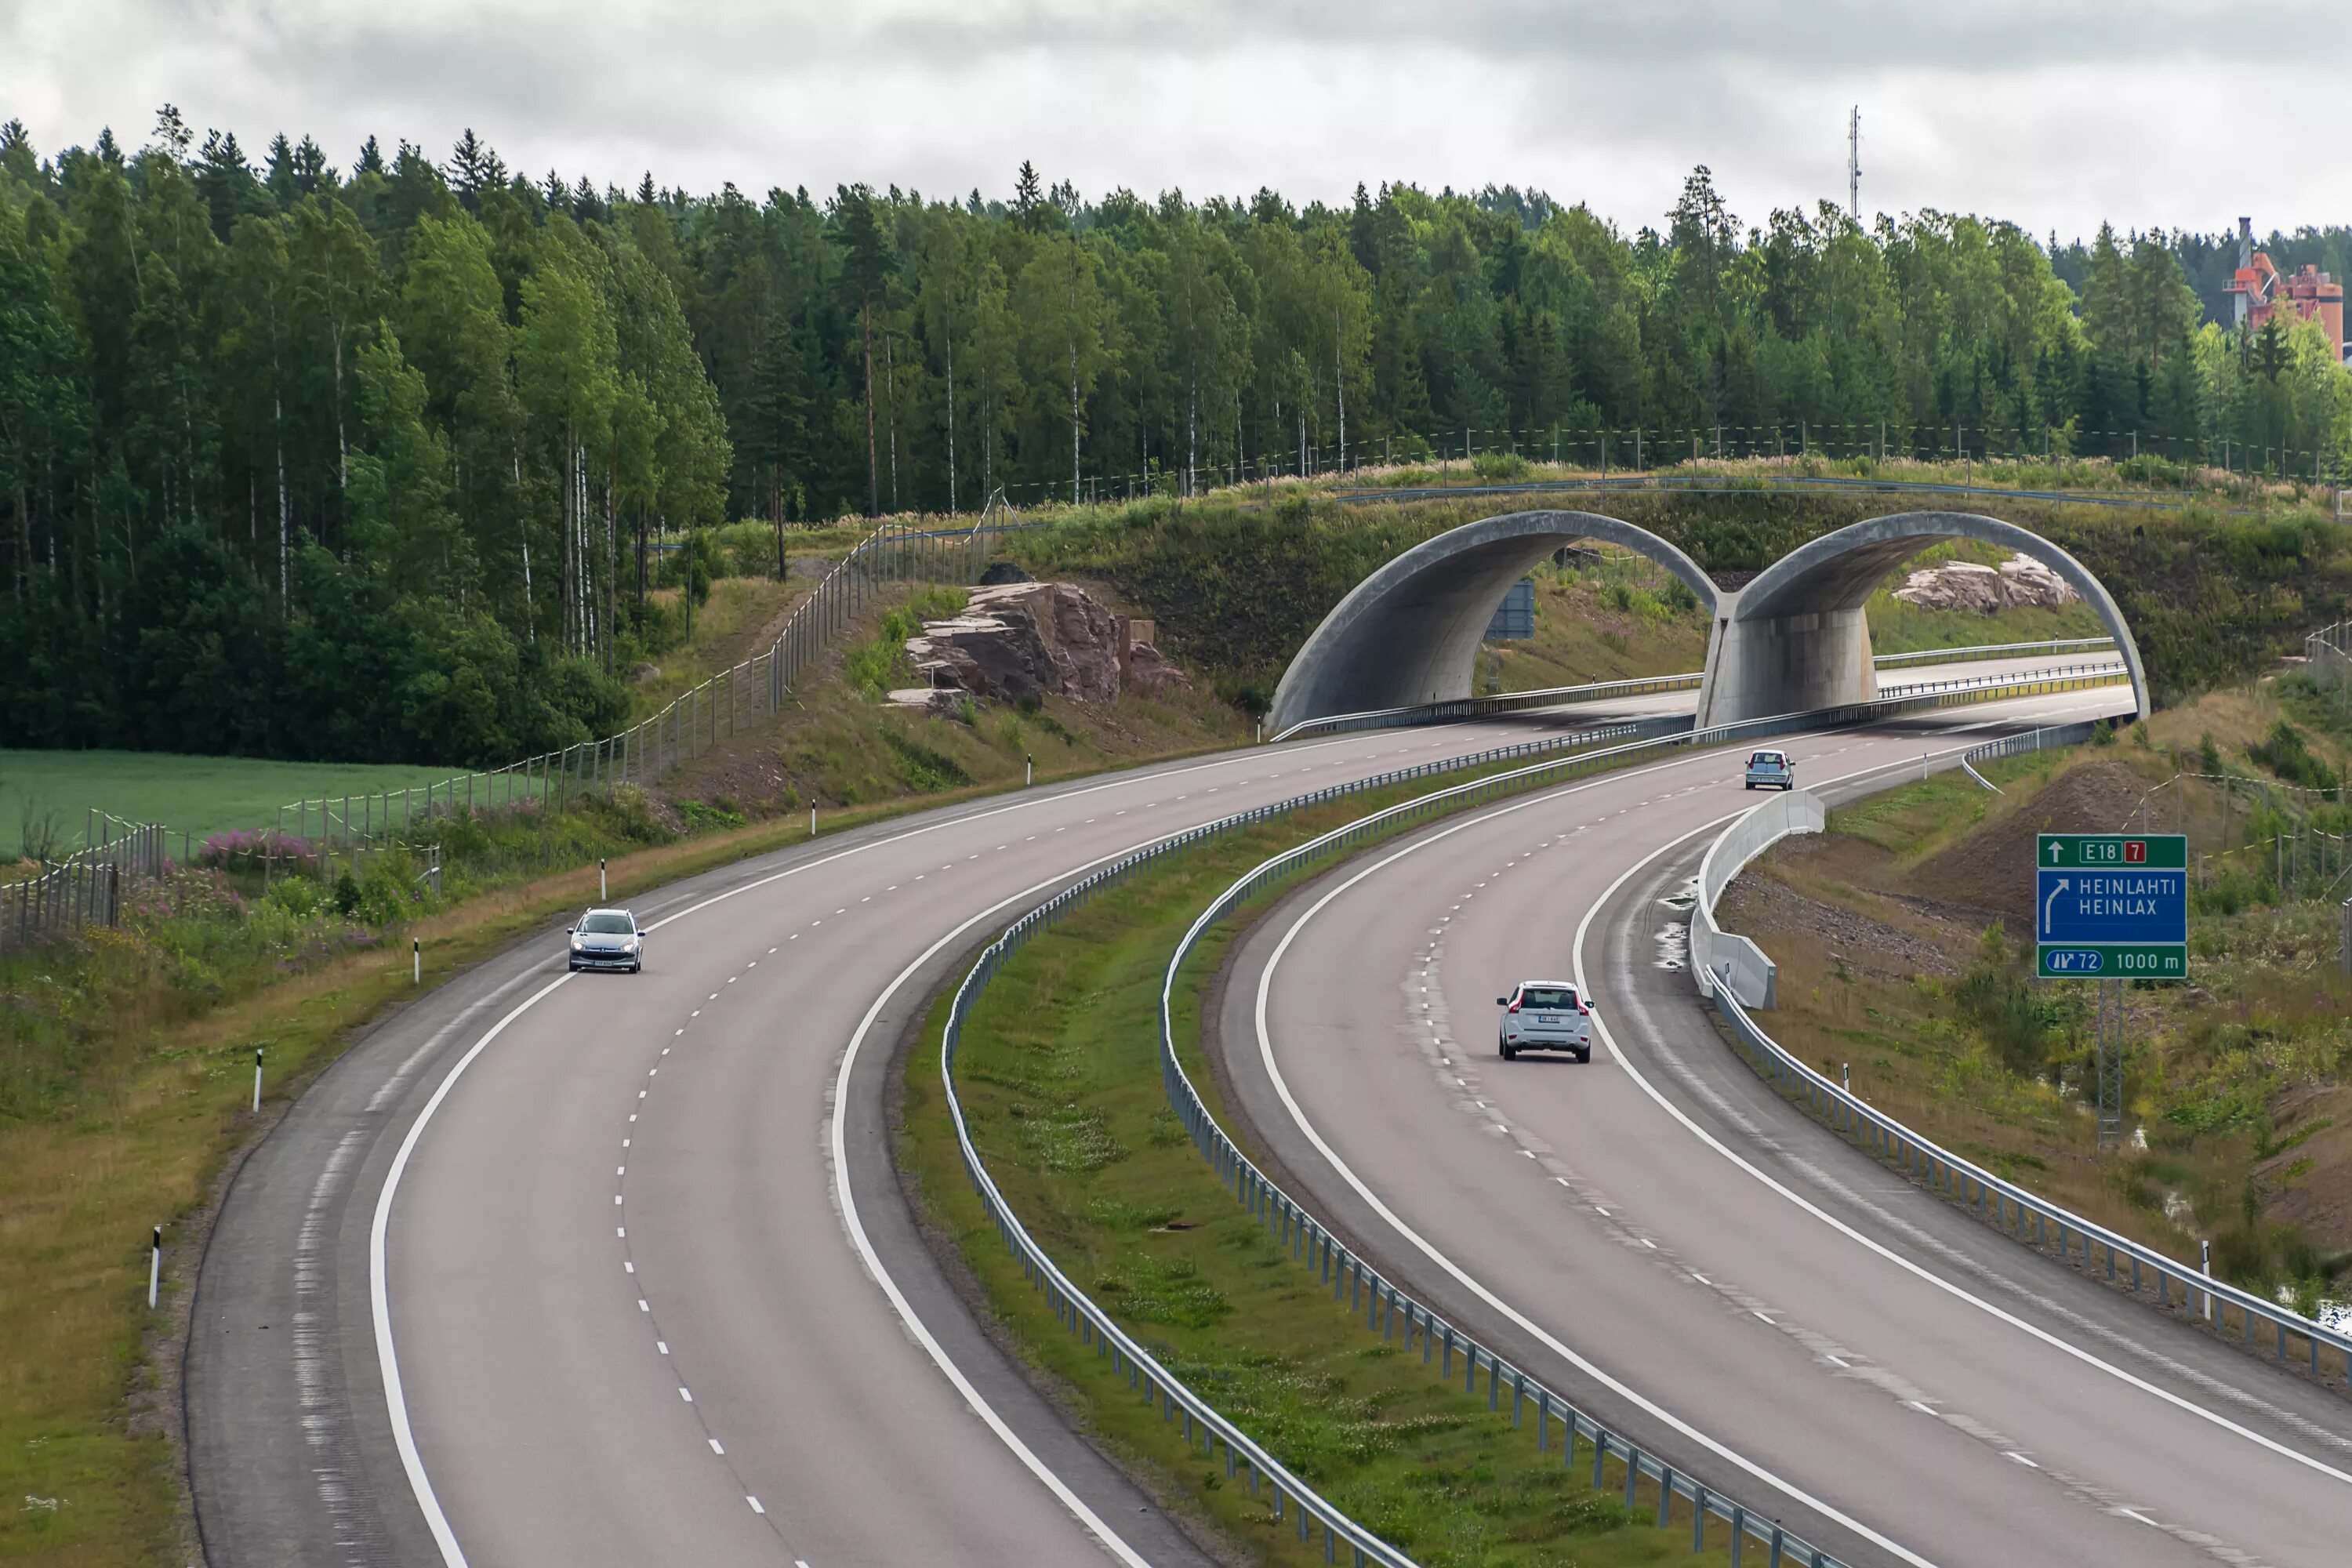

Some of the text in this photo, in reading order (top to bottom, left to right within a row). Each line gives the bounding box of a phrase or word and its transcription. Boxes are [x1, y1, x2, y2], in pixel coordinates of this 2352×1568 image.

[2086, 844, 2140, 860] E18 7
[2080, 879, 2176, 895] HEINLAHTI
[2080, 899, 2157, 915] HEINLAX
[2079, 953, 2097, 969] 72
[2118, 953, 2179, 969] 1000 m
